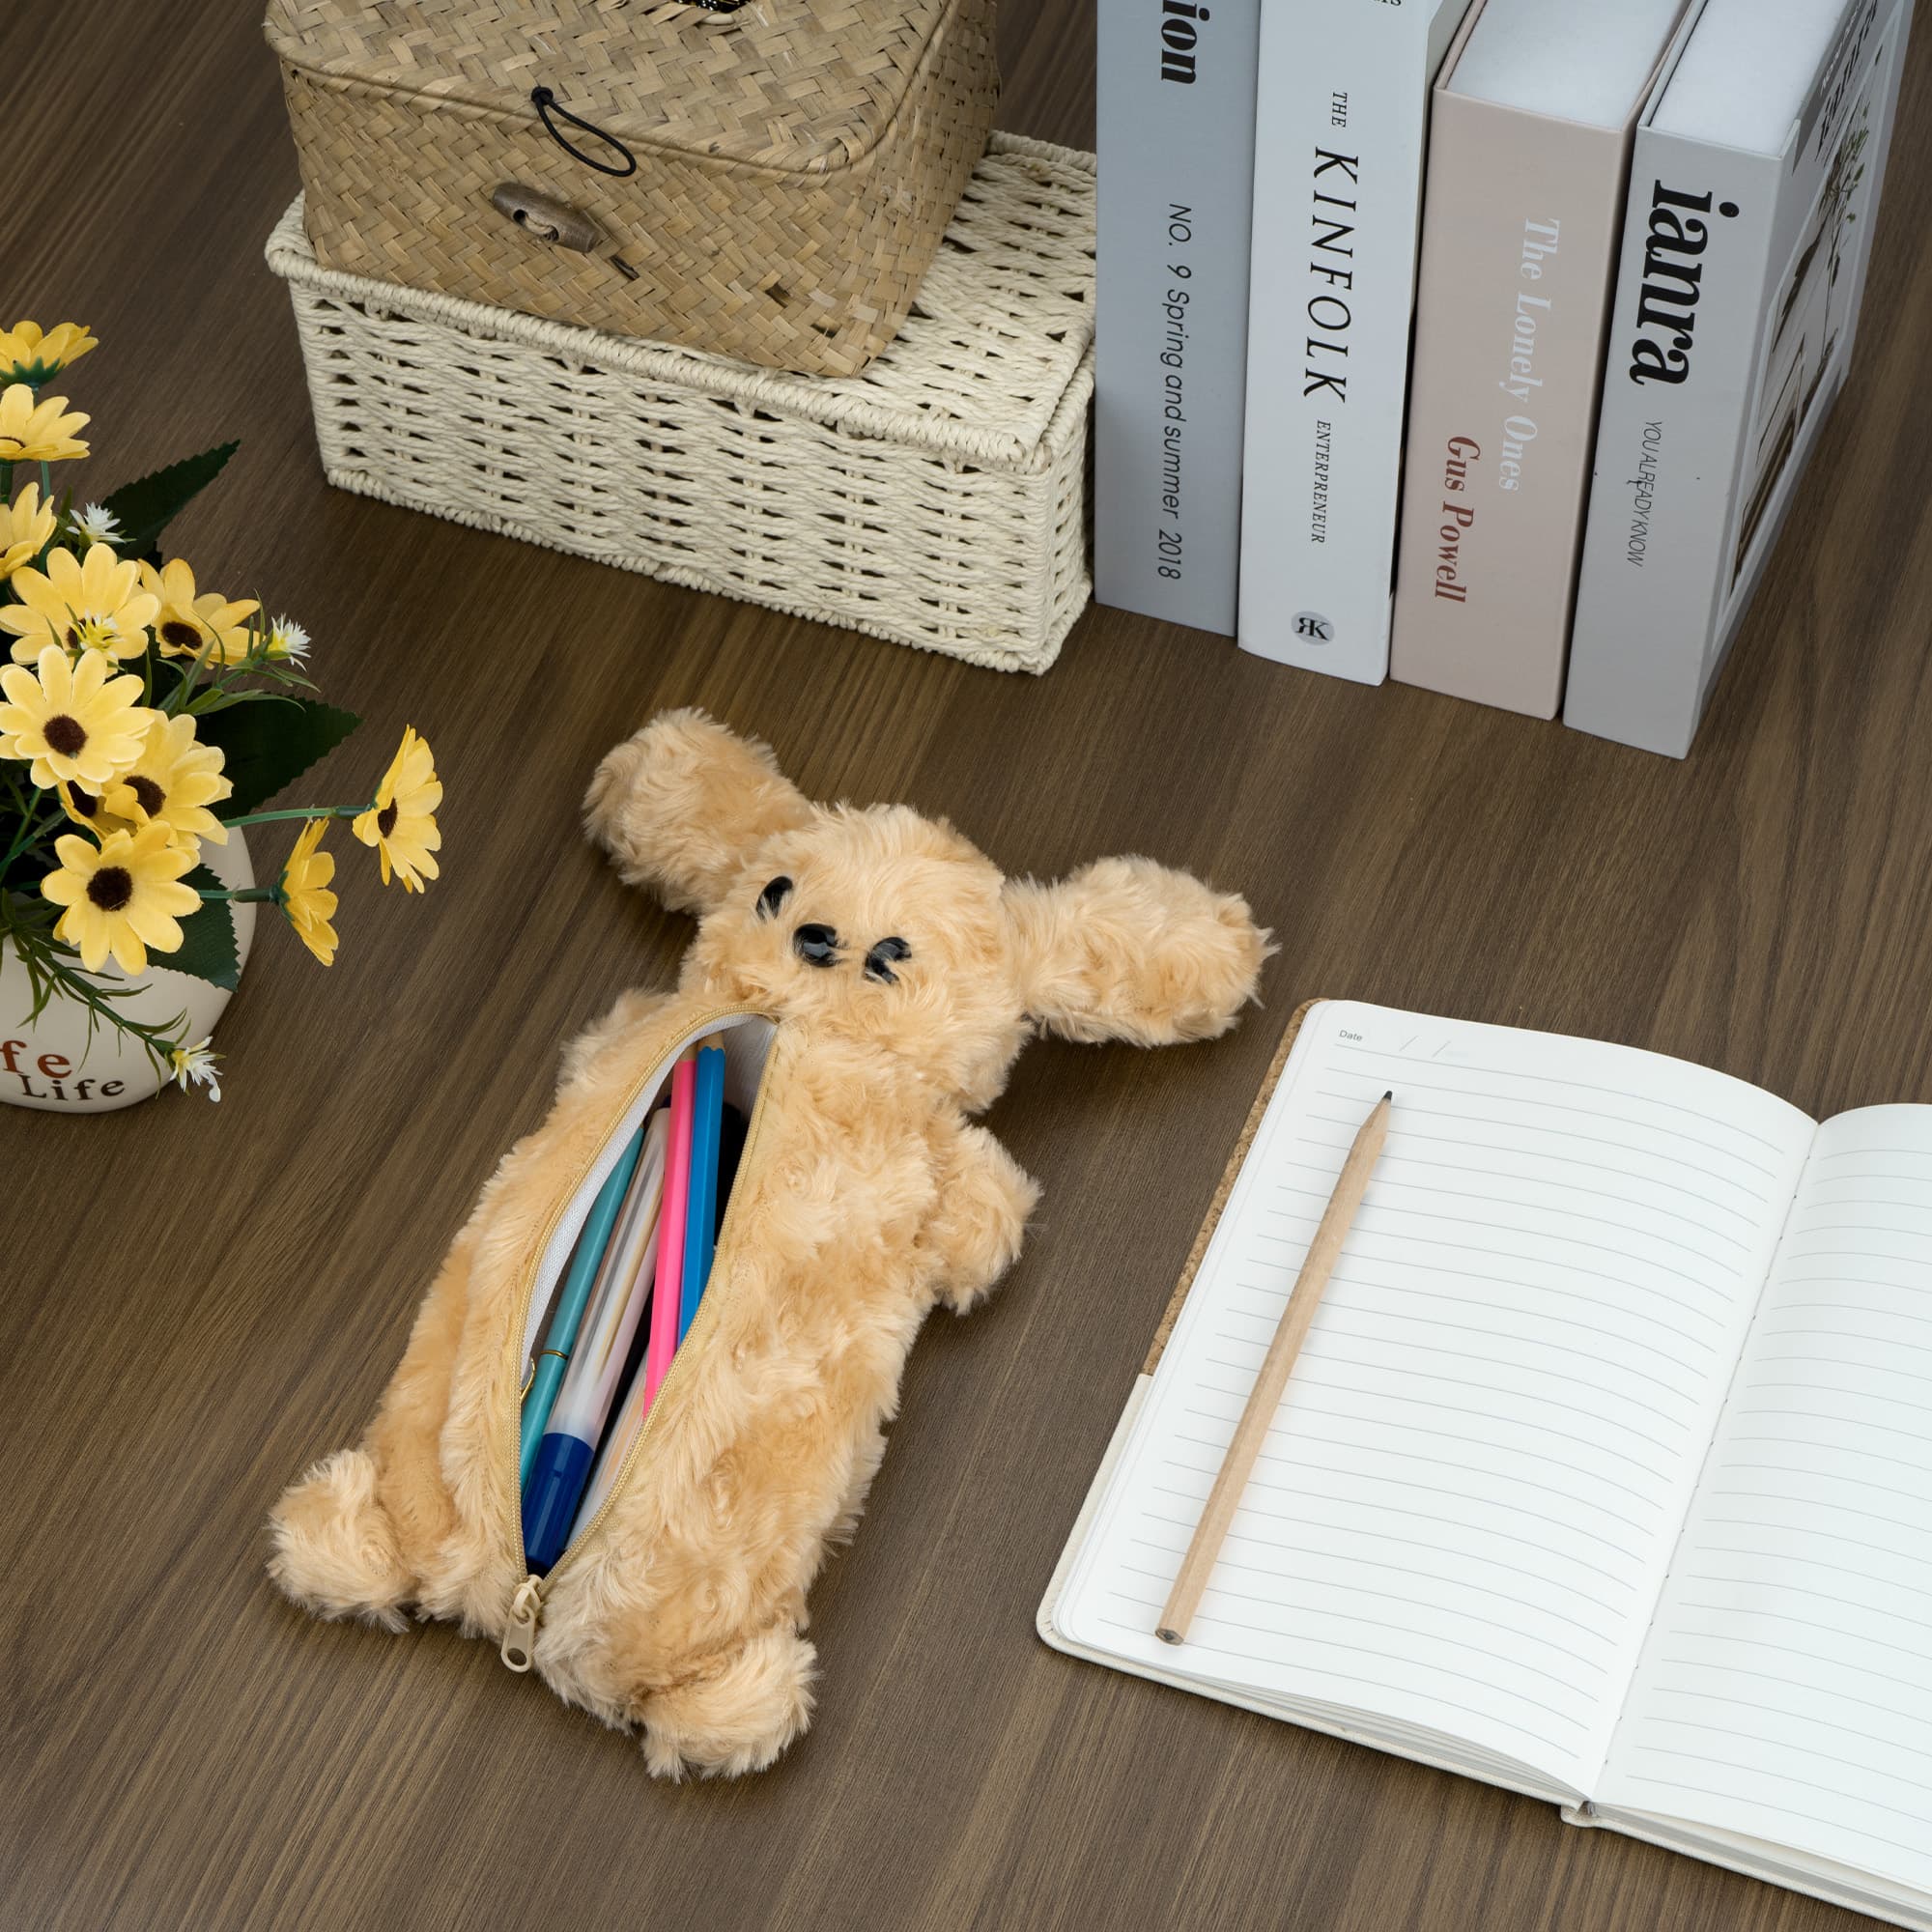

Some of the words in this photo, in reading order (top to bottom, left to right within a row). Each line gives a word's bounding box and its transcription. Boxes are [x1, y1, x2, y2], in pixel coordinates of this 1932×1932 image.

[1331, 92, 1349, 128] THE
[1168, 203, 1192, 246] NO.
[1520, 218, 1560, 280] The
[1167, 265, 1191, 279] 9
[1303, 147, 1359, 403] KINFOLK
[1630, 180, 1740, 385] ianra
[1160, 289, 1190, 369] Spring
[1499, 292, 1551, 402] Lonely
[1164, 375, 1186, 421] and
[1162, 425, 1182, 519] summer
[1311, 419, 1331, 543] ENTERPRENEUR
[1445, 436, 1481, 492] Gus
[1499, 415, 1538, 492] Ones
[1157, 529, 1182, 580] 2018
[1435, 501, 1475, 603] Powell
[1339, 1029, 1363, 1042] Date
[18, 1073, 126, 1101] Life
